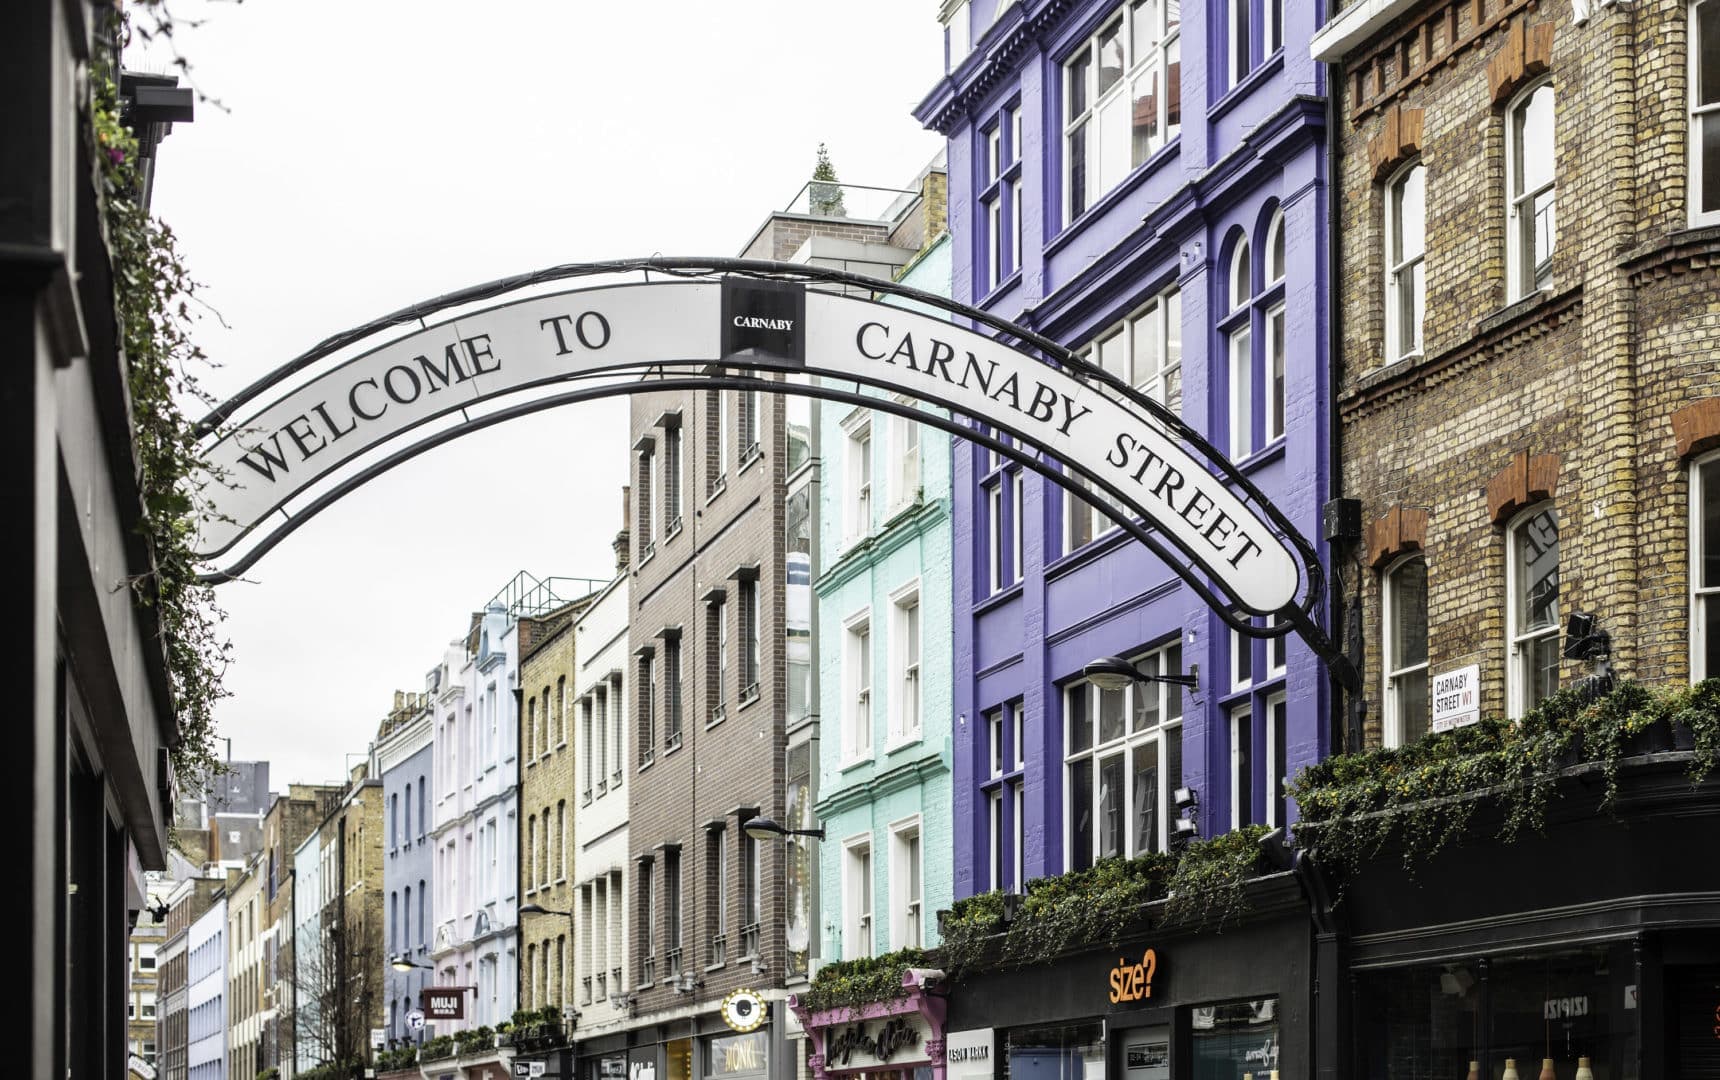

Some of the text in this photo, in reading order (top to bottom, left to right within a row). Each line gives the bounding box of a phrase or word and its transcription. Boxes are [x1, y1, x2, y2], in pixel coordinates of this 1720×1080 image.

[733, 315, 794, 331] CARNABY
[236, 310, 1263, 572] WELCOME TO CARNABY STREET
[1436, 673, 1468, 695] CARNABY
[1436, 690, 1472, 713] STREET W1
[1109, 948, 1157, 1004] size?
[431, 997, 457, 1009] MUJI
